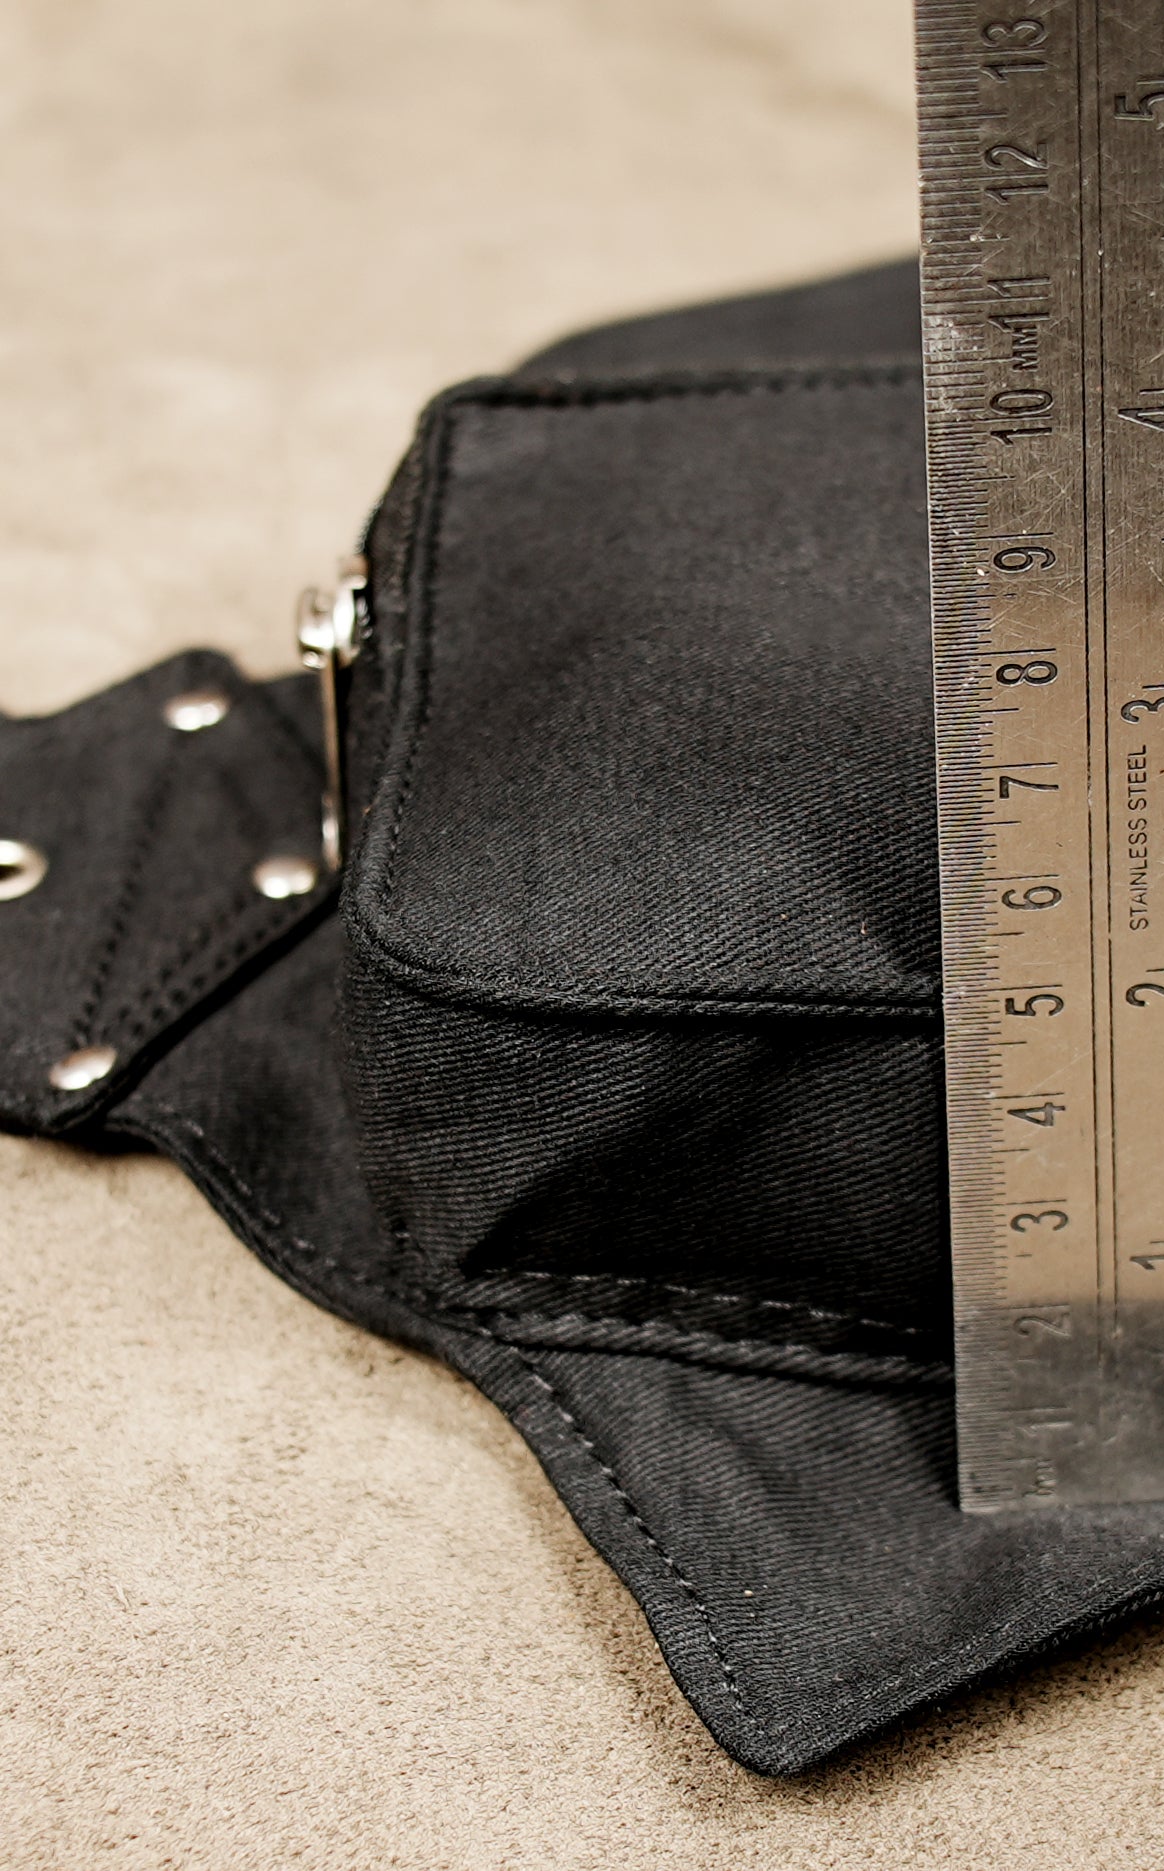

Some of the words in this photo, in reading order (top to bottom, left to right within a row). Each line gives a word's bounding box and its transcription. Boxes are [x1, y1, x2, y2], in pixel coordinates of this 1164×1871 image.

[981, 19, 1048, 83] 13
[984, 143, 1049, 205] 12
[987, 276, 1050, 333] 11
[1012, 325, 1039, 372] MM
[989, 389, 1053, 446] 10
[993, 545, 1056, 574] 9
[996, 660, 1058, 686] 8
[1000, 775, 1059, 800] 7
[1127, 744, 1147, 811] STEEL
[1128, 817, 1149, 930] STAINLESS
[1001, 886, 1062, 912] 6
[1005, 994, 1065, 1017] 5
[1006, 1102, 1066, 1128] 4
[1010, 1210, 1069, 1233] 3
[1013, 1313, 1071, 1338] 2
